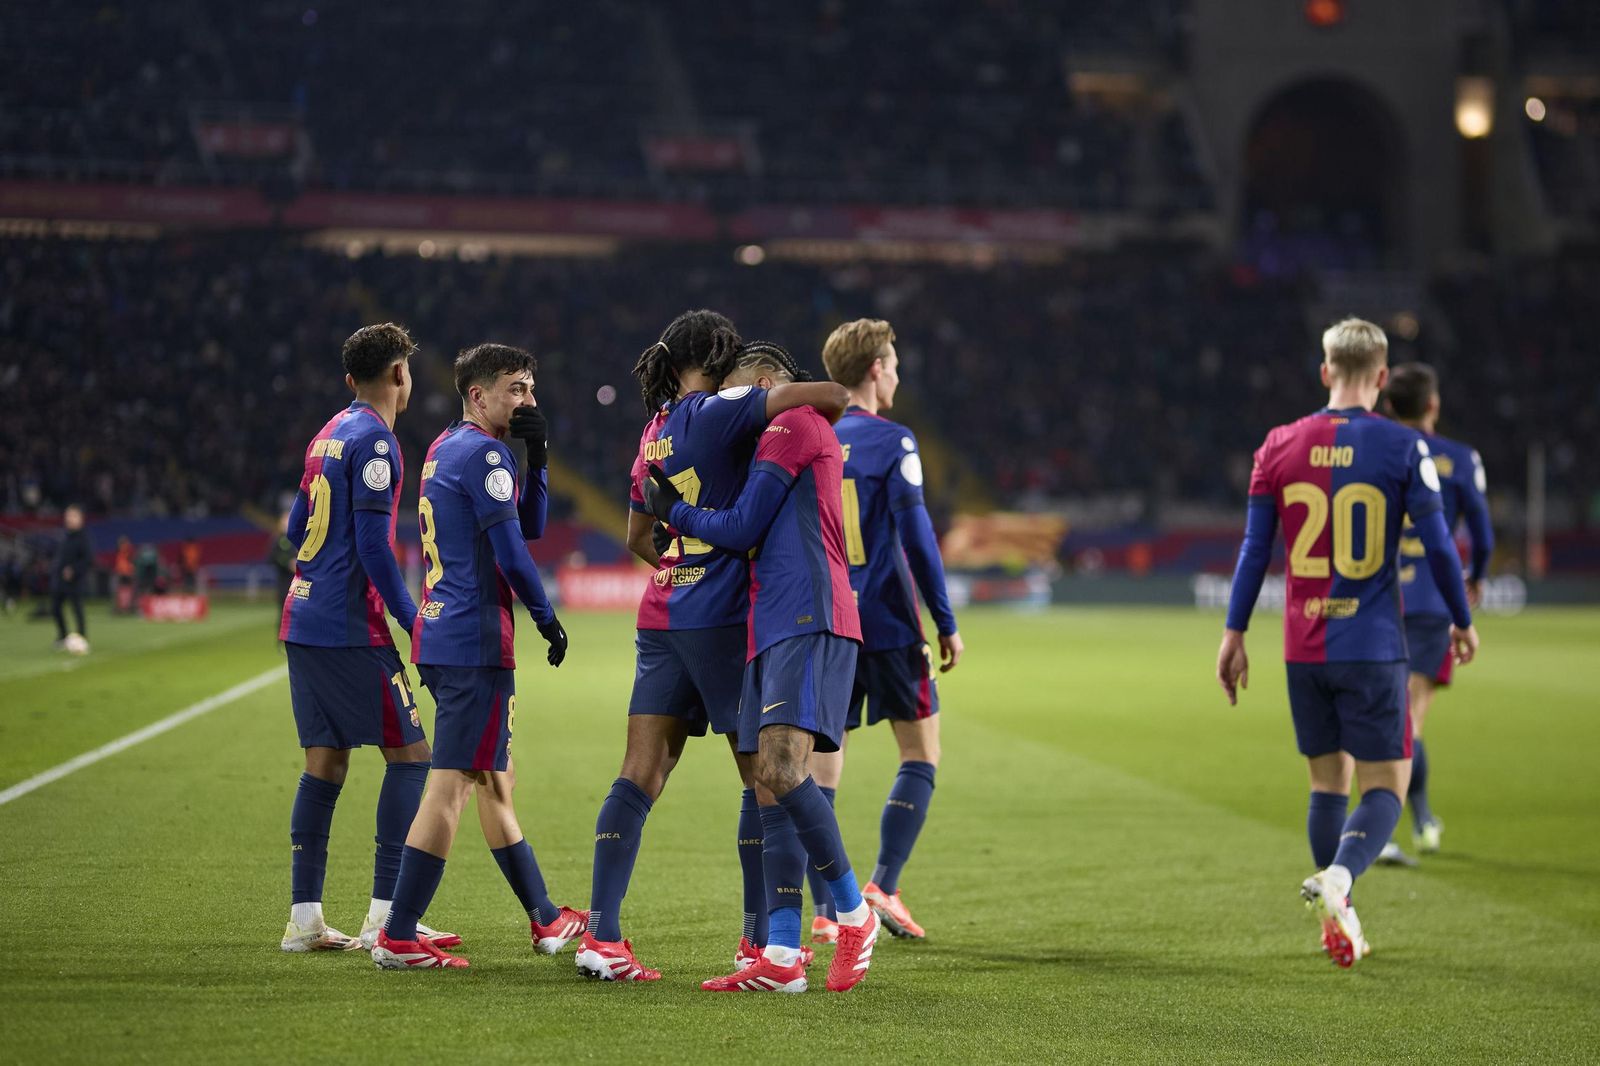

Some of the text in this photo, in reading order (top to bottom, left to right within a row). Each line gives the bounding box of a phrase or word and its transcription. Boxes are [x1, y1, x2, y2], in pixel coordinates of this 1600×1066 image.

[1309, 445, 1354, 468] OLMO
[418, 496, 443, 590] 8
[1282, 482, 1387, 580] 20
